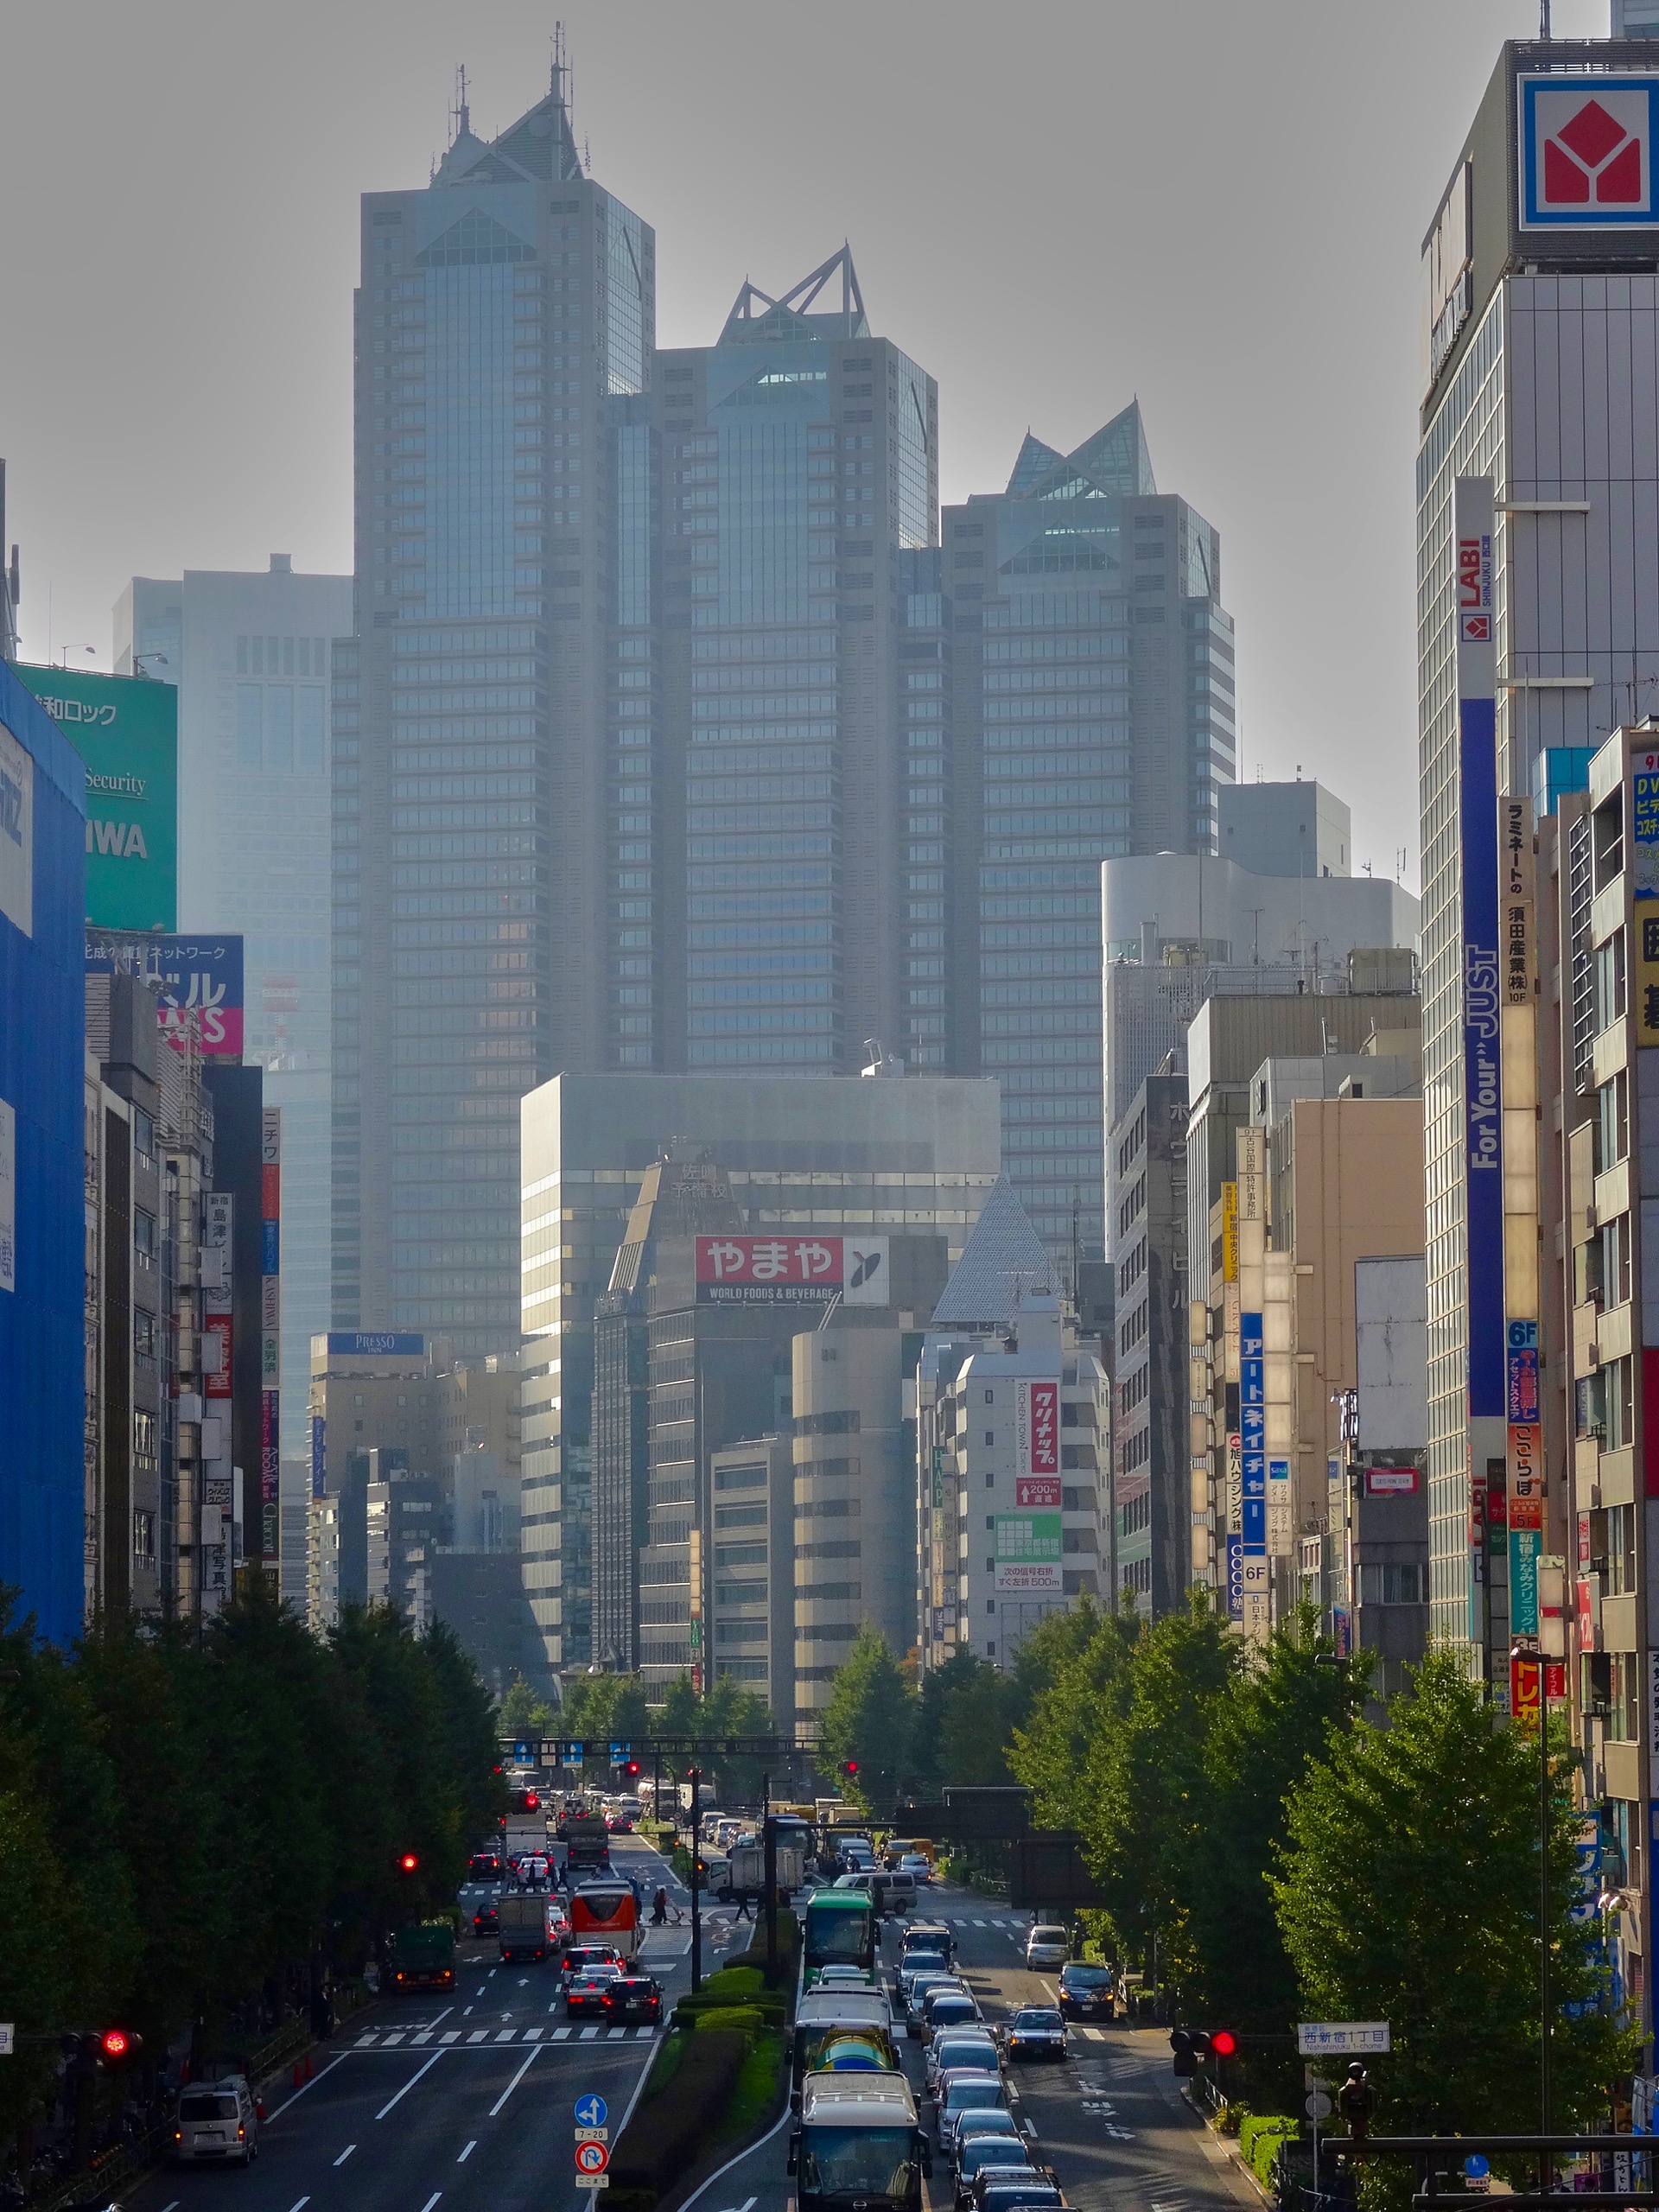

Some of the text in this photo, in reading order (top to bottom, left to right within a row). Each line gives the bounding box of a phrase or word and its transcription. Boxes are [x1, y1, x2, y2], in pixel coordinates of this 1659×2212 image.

[1460, 539, 1481, 607] LABI
[1482, 563, 1491, 607] SHINJUKU
[35, 694, 118, 726] 和ロック
[85, 767, 147, 796] Security
[1508, 804, 1523, 894] ラミネートの
[1509, 991, 1526, 1002] 10F
[1465, 944, 1499, 1169] For Your JUST
[707, 1242, 833, 1280] やまや
[709, 1287, 743, 1300] WORLD
[744, 1287, 774, 1300] FOODS
[776, 1287, 785, 1300] &
[1508, 1321, 1537, 1347] 6F
[1018, 1382, 1027, 1421] KITCHEN
[1510, 1357, 1520, 1420] アセットスクエア
[1034, 1392, 1056, 1465] クリナップ
[1243, 1338, 1264, 1518] アートネイチャー
[1030, 1484, 1058, 1494] 200m
[1516, 1514, 1535, 1528] 5F
[1003, 1567, 1054, 1577] 次の信号右折
[1031, 1577, 1060, 1587] 500m
[1246, 1567, 1266, 1580] 6F
[1304, 2030, 1383, 2044] 西新宿1丁目
[1306, 2043, 1382, 2052] Nishishinjuku 1-chome
